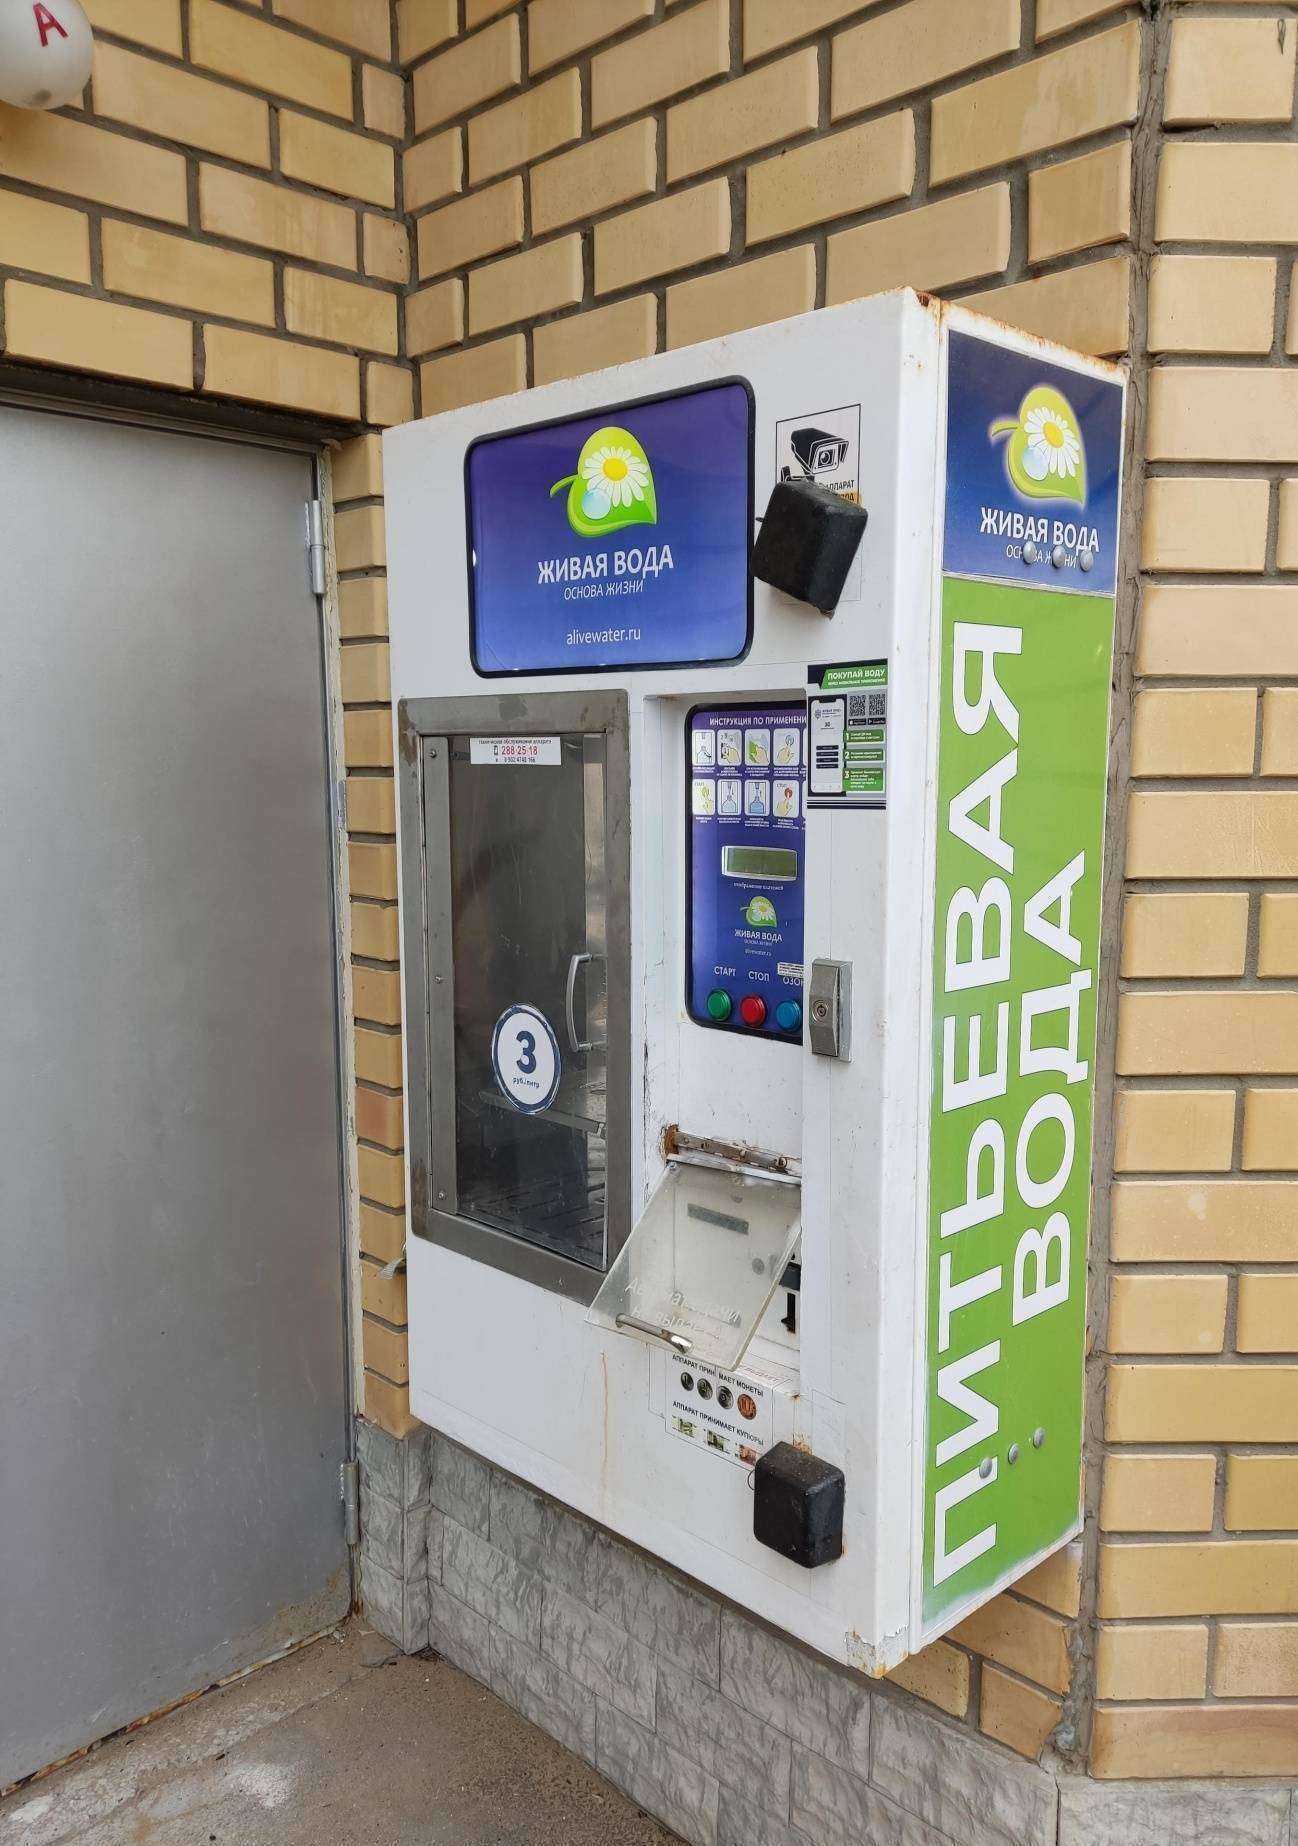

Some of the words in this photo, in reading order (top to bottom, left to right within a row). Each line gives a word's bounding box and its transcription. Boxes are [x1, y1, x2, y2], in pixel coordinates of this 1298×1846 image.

[980, 506, 1048, 543] ЖИВАЯ
[1053, 521, 1099, 556] ВОДА
[537, 553, 608, 584] ЖИВАЯ
[614, 545, 674, 579] ВОДА
[564, 583, 603, 600] ОСНОВА
[605, 579, 644, 597] ЖИЗНИ
[566, 628, 641, 645] alivewater.ru
[709, 717, 751, 726] ИНСТРУКЦИЯ
[753, 717, 763, 725] ПО
[501, 746, 515, 755] 288
[517, 746, 526, 755] 25
[529, 746, 538, 755] 18
[734, 928, 761, 939] ЖИВАЯ
[761, 932, 783, 943] ВОДА
[714, 966, 736, 977] СТАРТ
[748, 970, 770, 982] СТОП
[516, 1030, 537, 1075] 3
[1012, 849, 1092, 1327] ВОДА
[932, 620, 1023, 1588] ПИТЬЕВАЯ
[736, 1380, 764, 1397] МОНЕТЫ
[672, 1401, 699, 1416] АППАРАТ
[699, 1413, 736, 1433] ПРИНИМАЕТ
